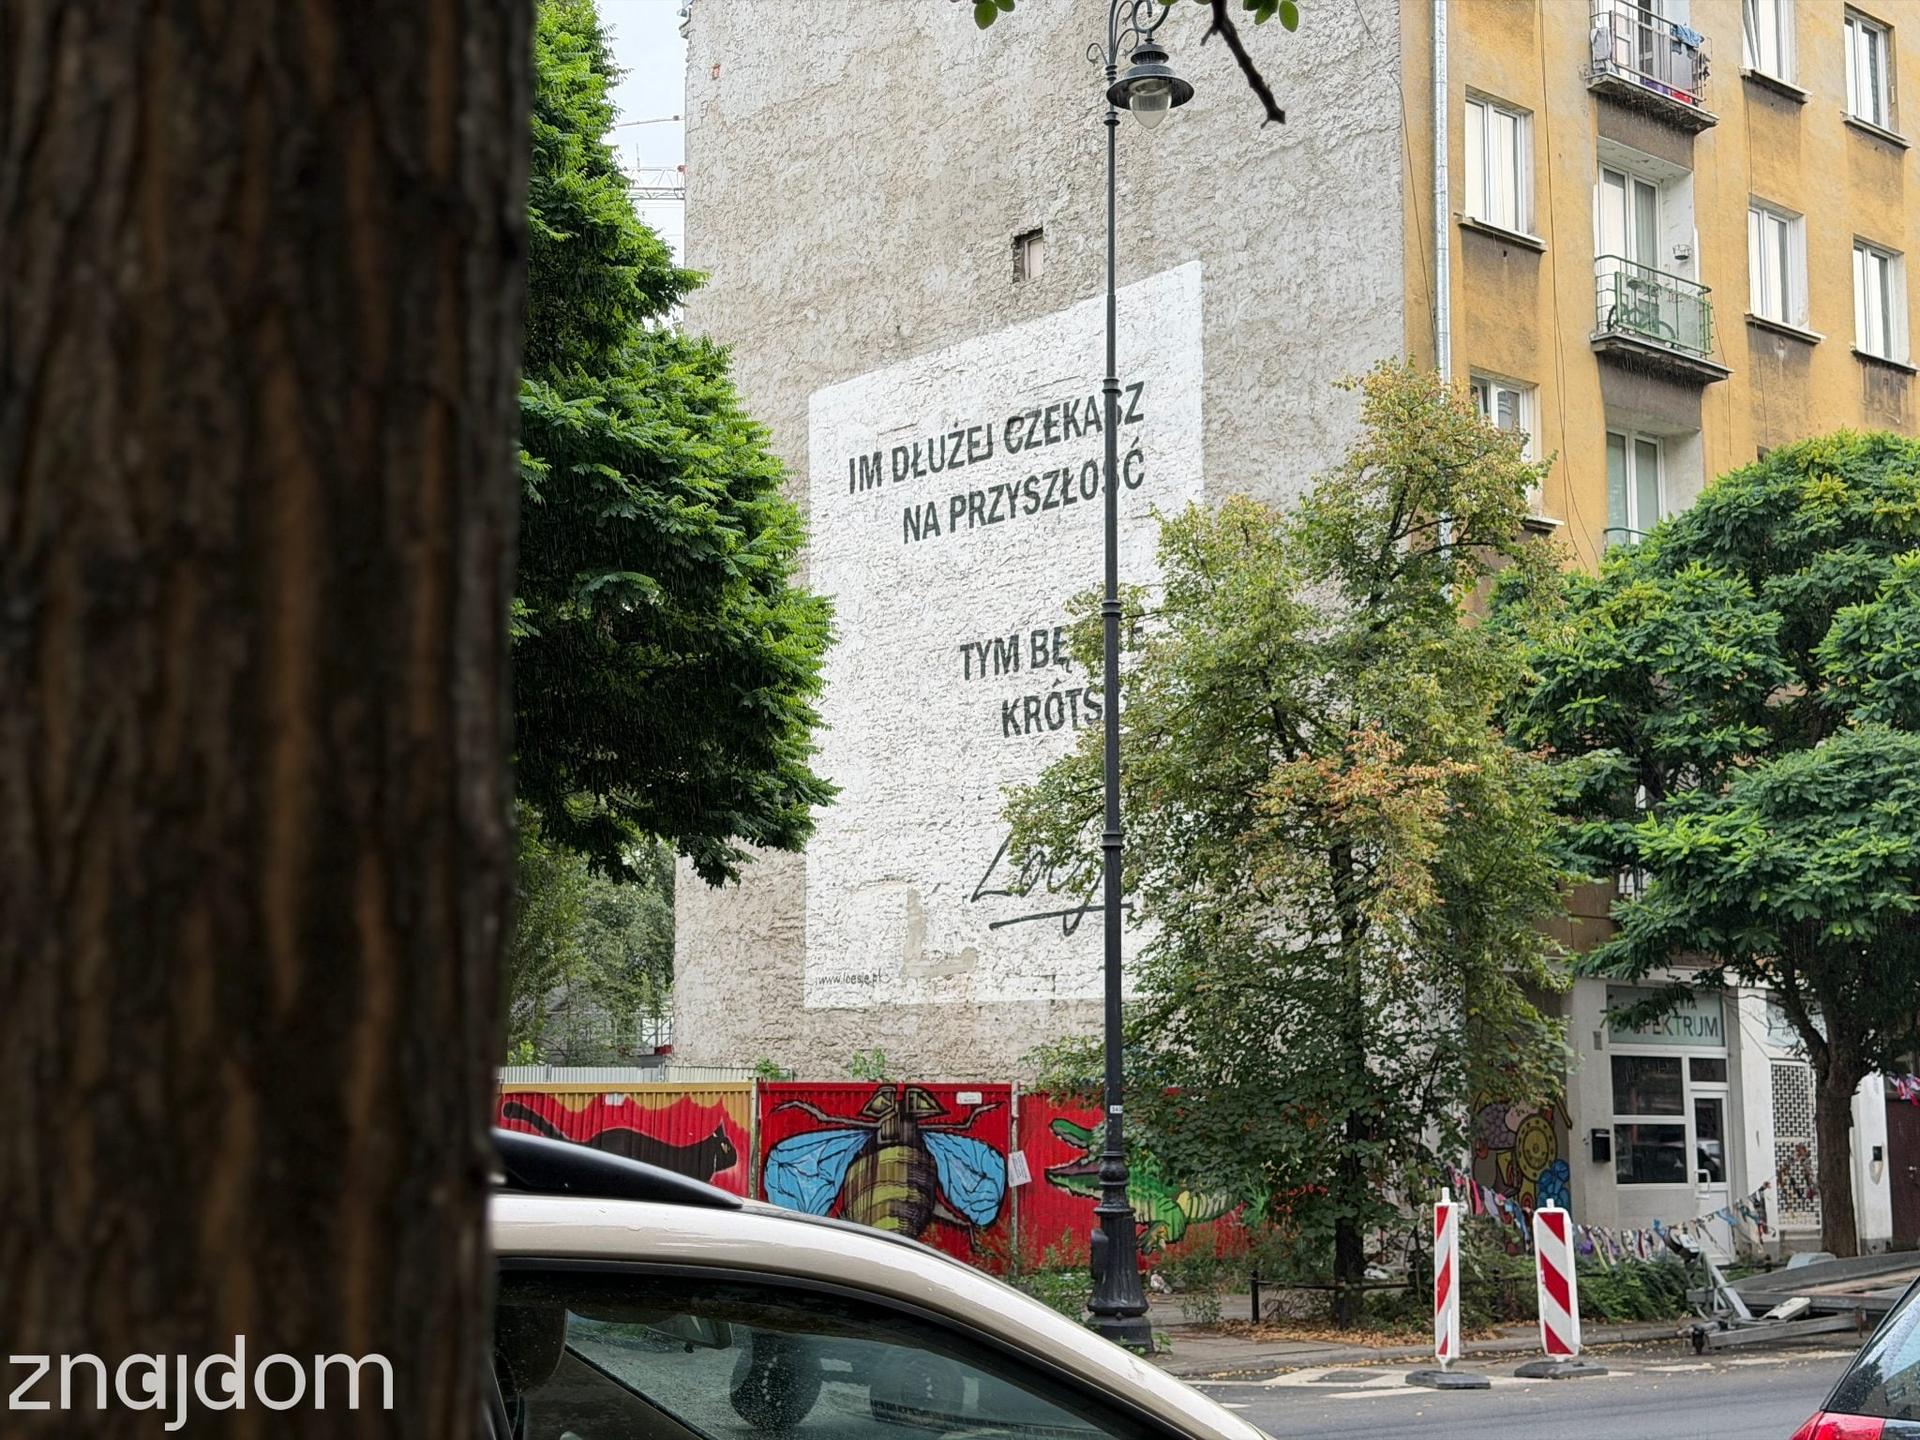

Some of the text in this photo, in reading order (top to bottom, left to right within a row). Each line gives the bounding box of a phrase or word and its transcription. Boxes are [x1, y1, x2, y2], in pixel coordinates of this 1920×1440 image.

[849, 451, 883, 494] IM
[892, 422, 994, 483] DŁUŻEJ
[903, 501, 941, 544] NA
[960, 634, 1020, 681] TYM
[1001, 677, 1106, 738] KRÓTS
